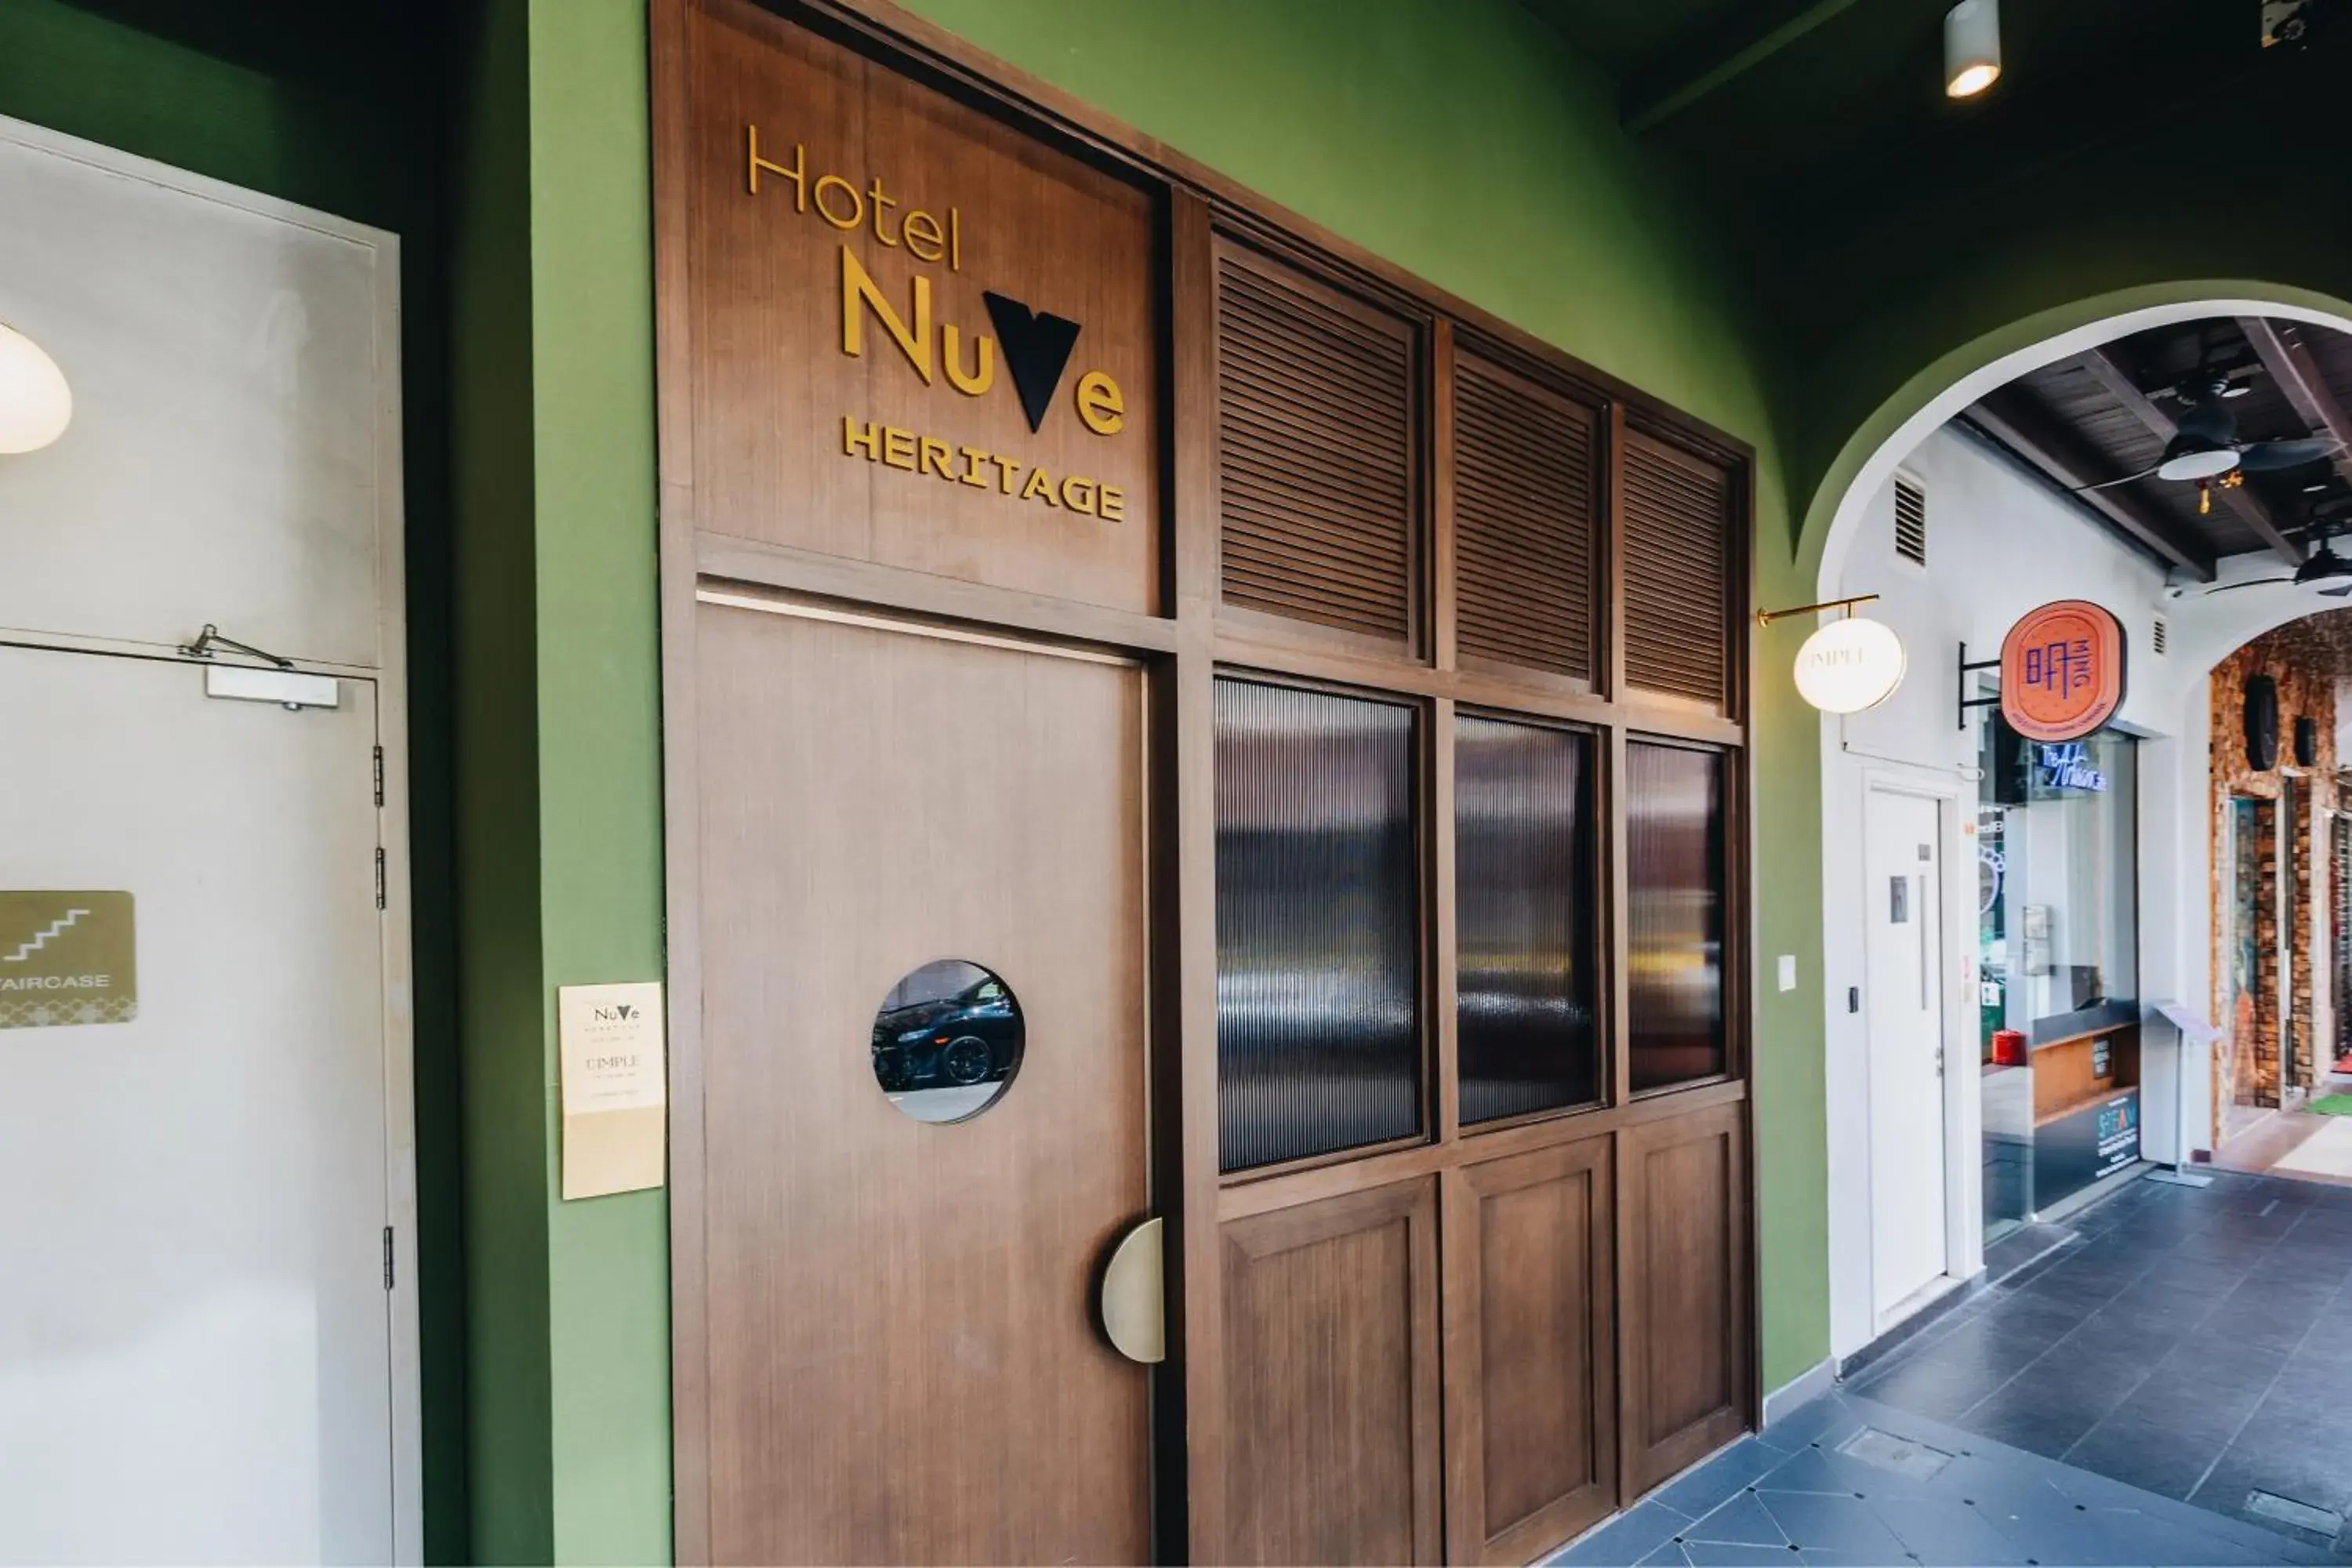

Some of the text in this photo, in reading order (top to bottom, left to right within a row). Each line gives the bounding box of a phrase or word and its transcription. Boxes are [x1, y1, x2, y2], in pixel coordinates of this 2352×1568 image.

[748, 124, 960, 271] Hotel
[843, 416, 1125, 522] HERITAGE
[0, 975, 111, 990] AIRCASE
